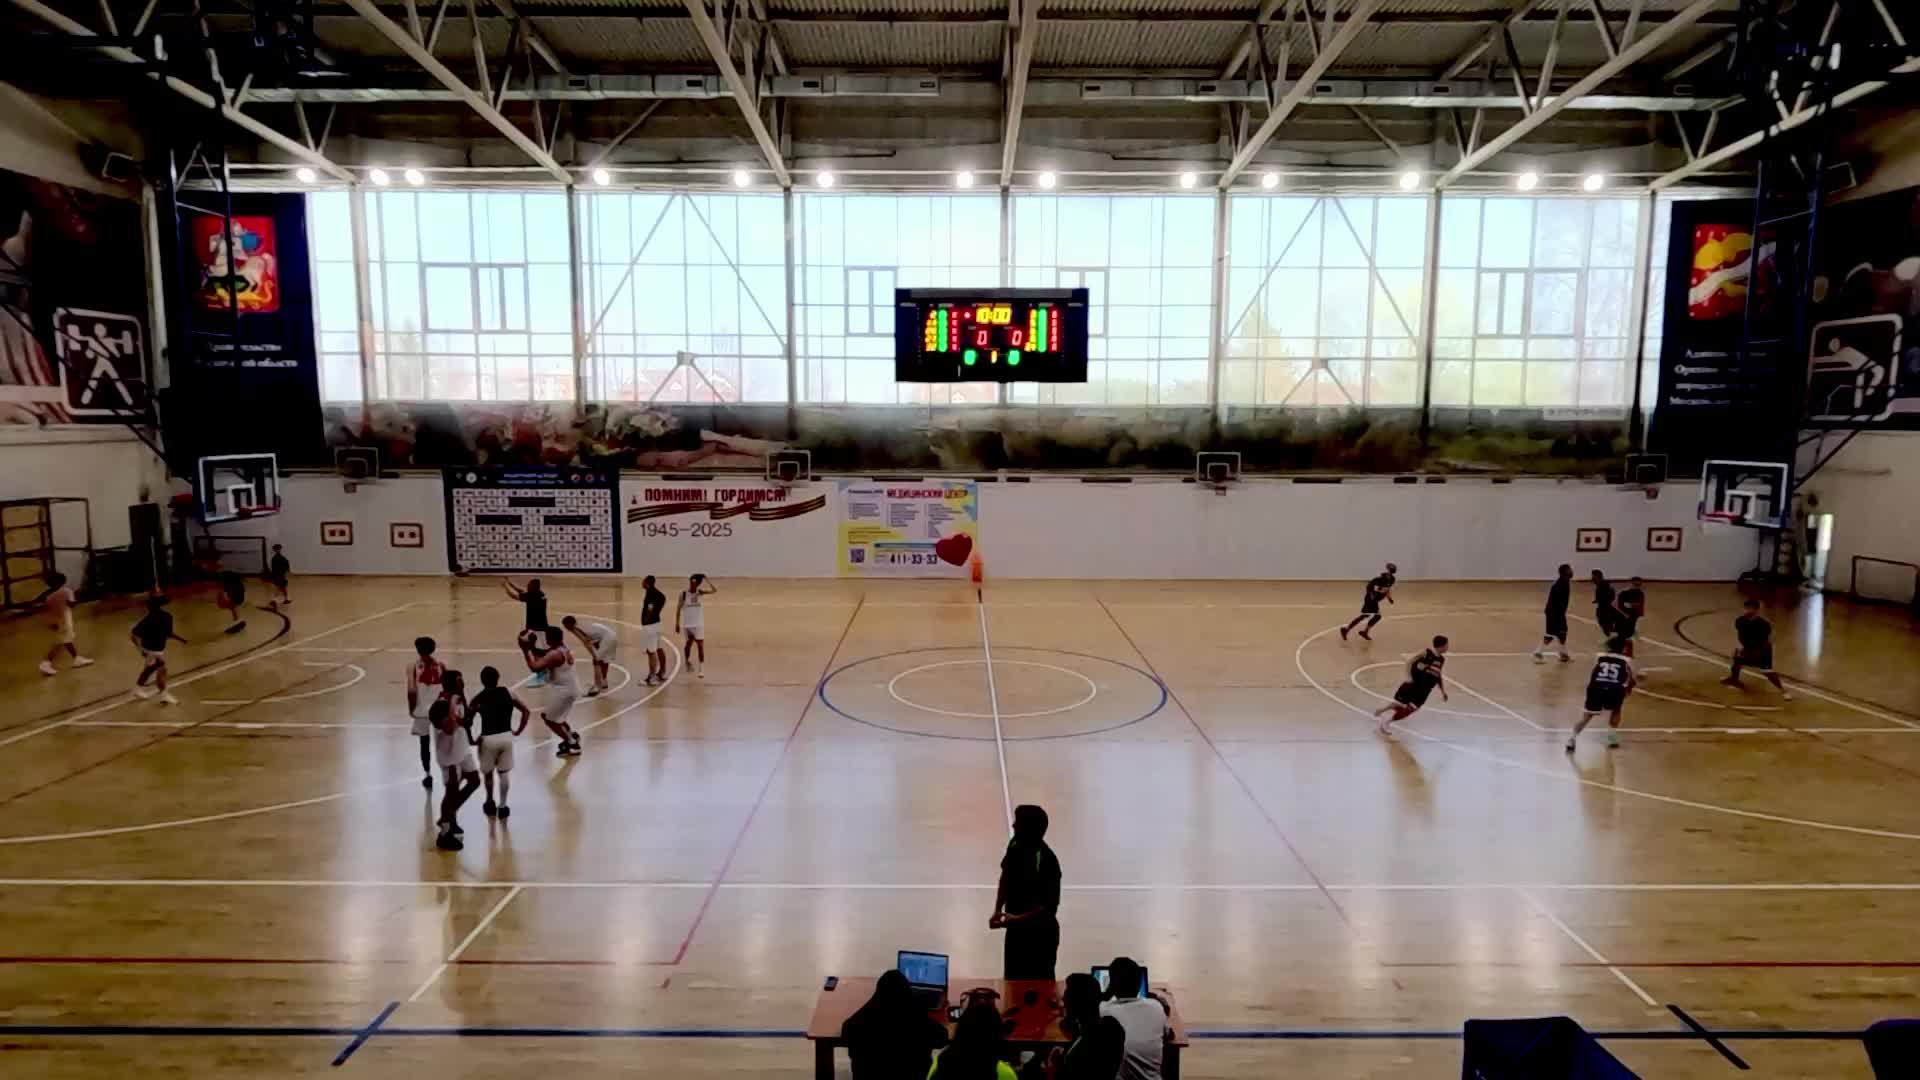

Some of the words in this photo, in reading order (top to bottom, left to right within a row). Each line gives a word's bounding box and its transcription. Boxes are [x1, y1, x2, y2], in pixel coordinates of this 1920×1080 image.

[976, 307, 1012, 324] 10:00
[977, 330, 988, 346] 0
[1011, 330, 1022, 346] 0
[645, 488, 707, 502] ПОМНИМ!
[640, 523, 733, 537] 1945-2025
[1598, 661, 1621, 678] 35
